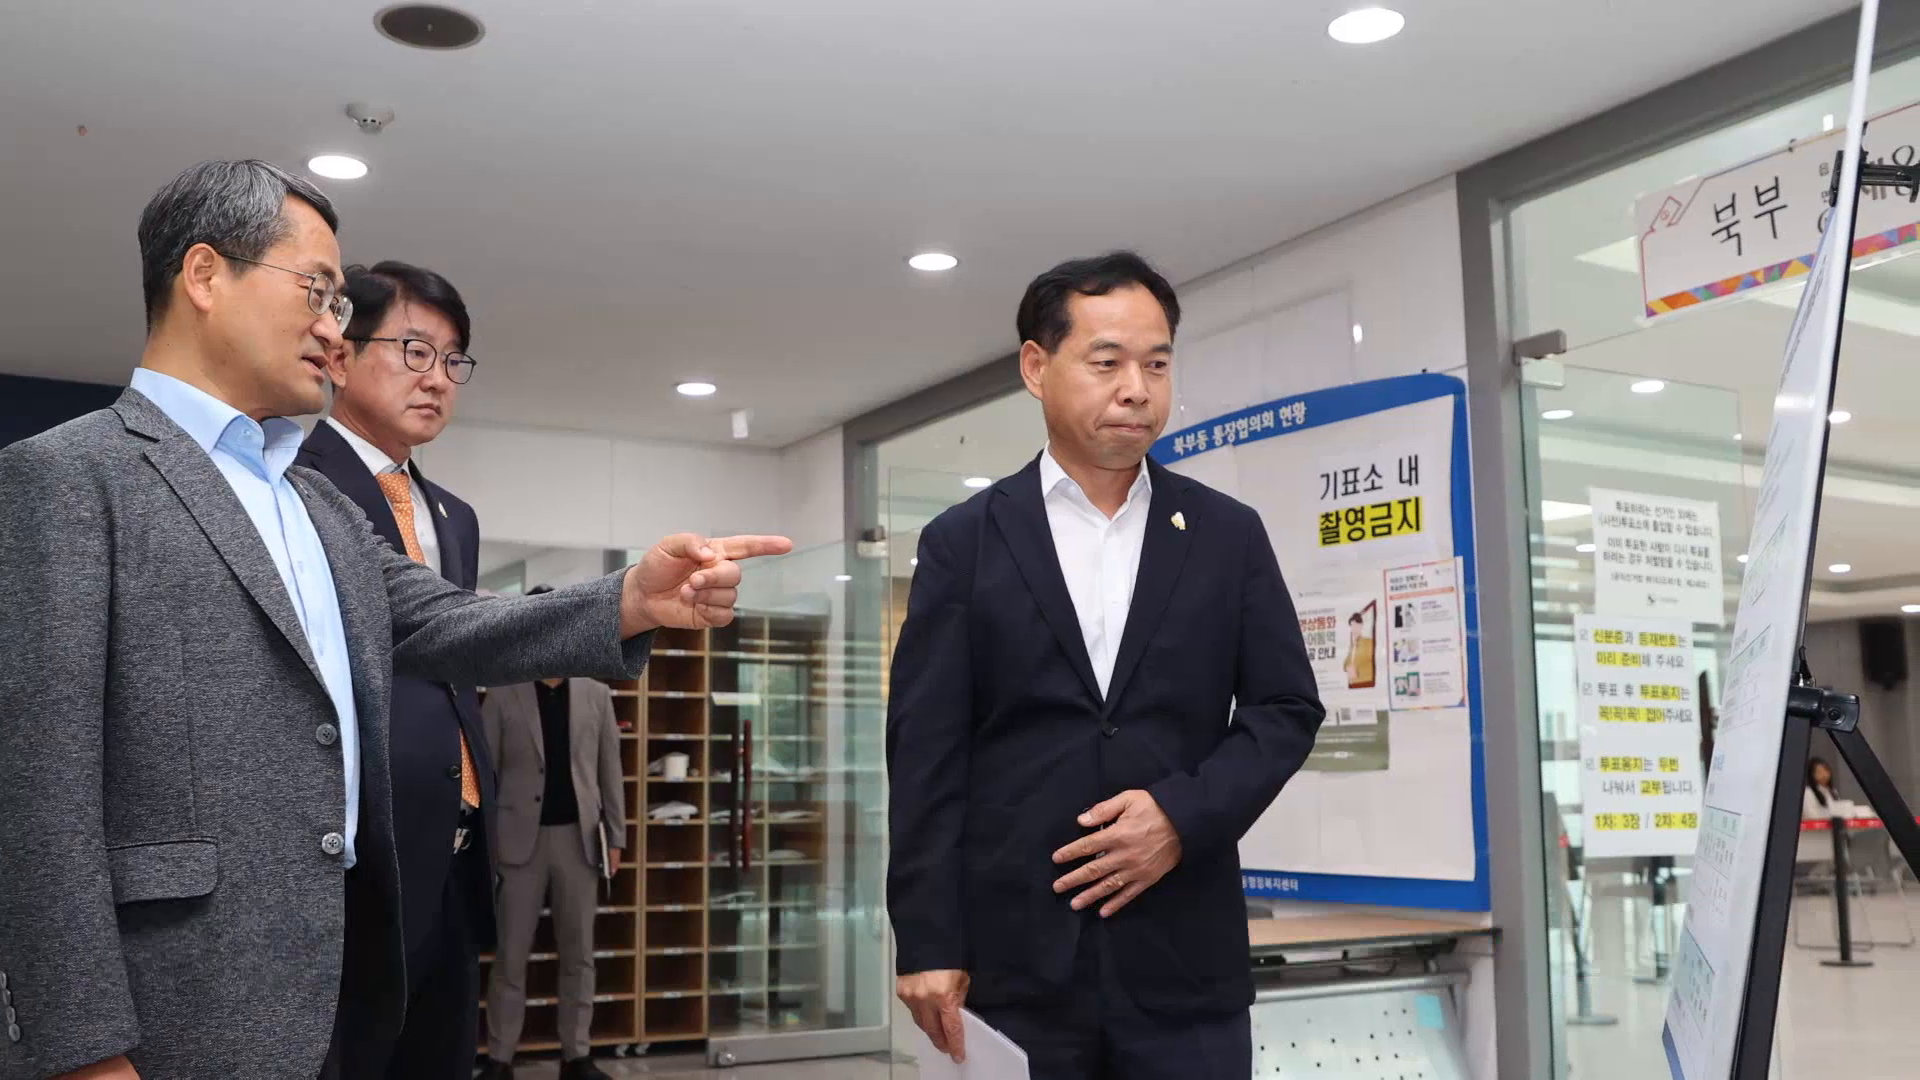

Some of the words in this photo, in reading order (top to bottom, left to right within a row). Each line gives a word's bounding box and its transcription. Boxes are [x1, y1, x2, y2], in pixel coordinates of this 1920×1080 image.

[1711, 175, 1788, 257] 북부
[1172, 433, 1209, 457] 북부동
[1212, 413, 1275, 448] 통장협의회
[1279, 400, 1308, 427] 현황
[1319, 463, 1384, 502] 기표소
[1398, 453, 1420, 487] 내
[1319, 496, 1422, 547] 촬영금지
[1304, 632, 1336, 646] 어통역
[1594, 629, 1634, 645] 신분증과
[1639, 631, 1689, 648] 등재번호는
[1318, 647, 1336, 660] 안내
[1596, 651, 1616, 665] 미리
[1621, 652, 1652, 668] 준비해
[1656, 653, 1685, 668] 주세요
[1598, 682, 1618, 698] 투표
[1624, 684, 1634, 698] 후
[1640, 684, 1691, 702] 투표용지는
[1600, 756, 1654, 773] 투표용지는
[1658, 756, 1679, 772] 두번
[1603, 780, 1636, 795] 나눠서
[1640, 780, 1697, 796] 교부됩니다.
[1595, 814, 1617, 830] 1차:
[1623, 813, 1640, 829] 3장
[1655, 813, 1676, 829] 2차:
[1681, 812, 1698, 829] 4장
